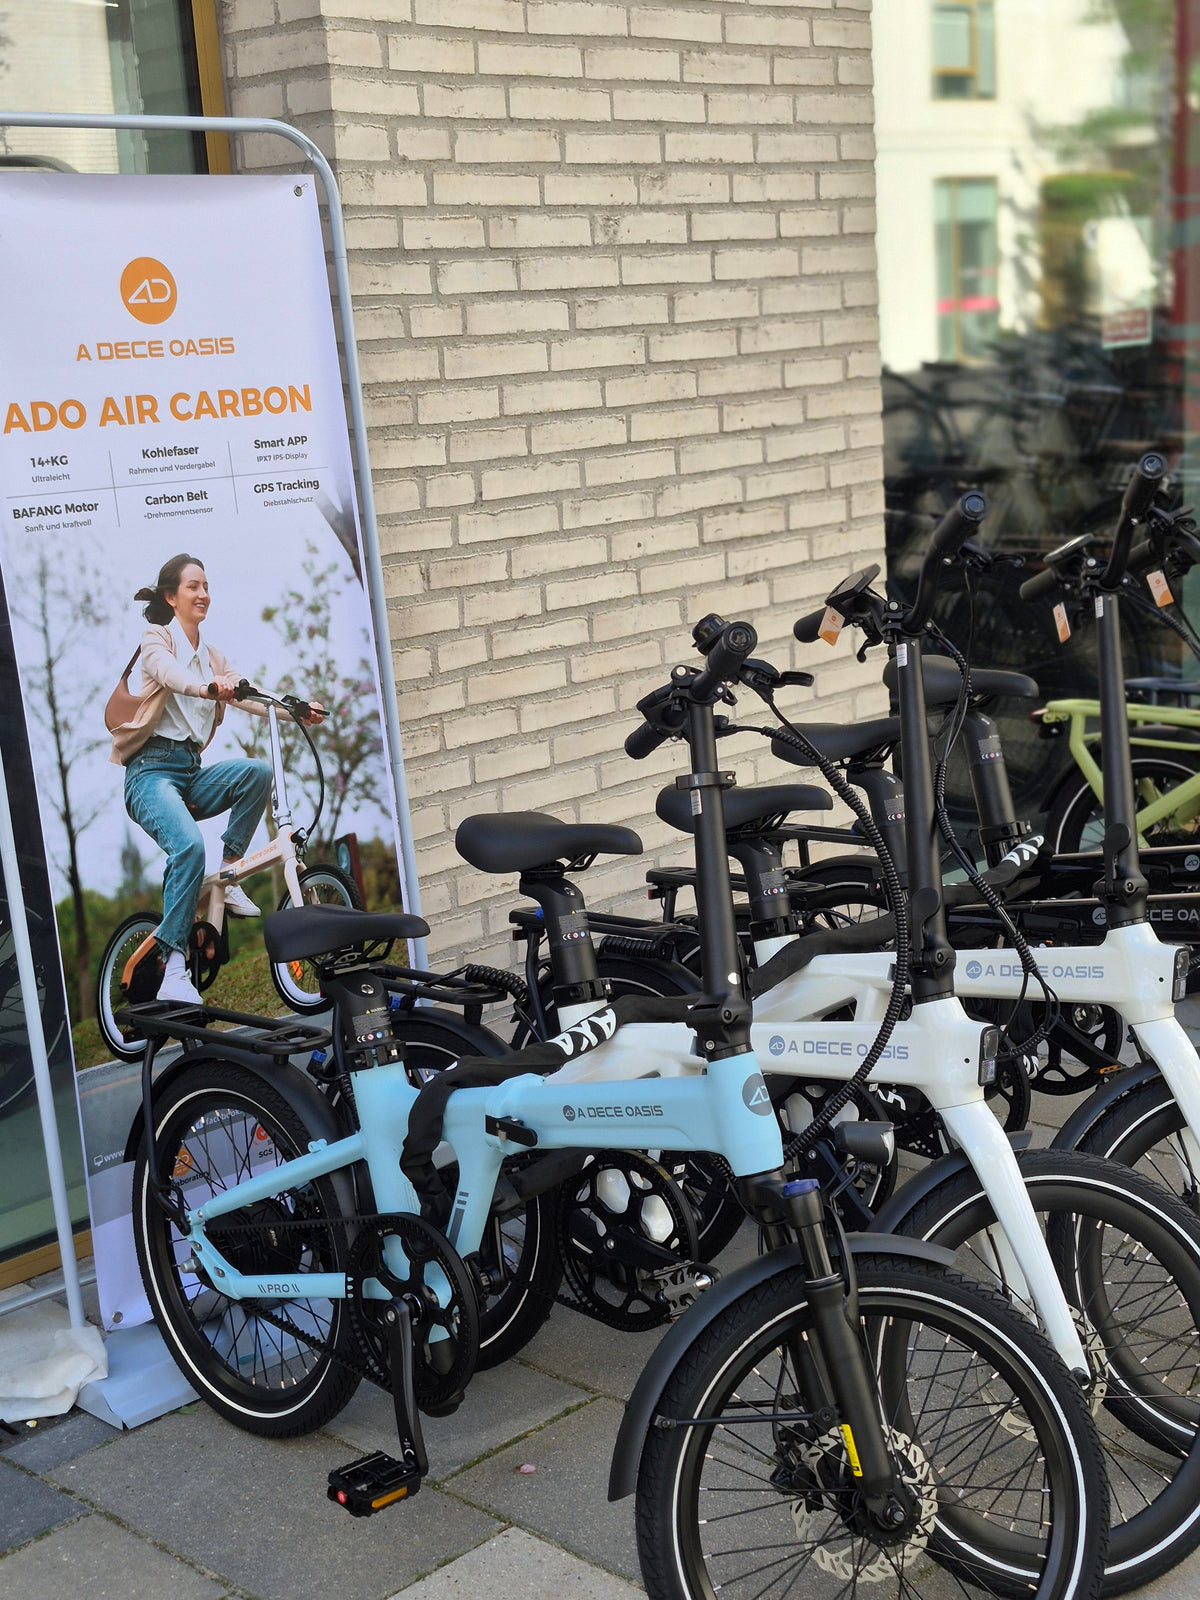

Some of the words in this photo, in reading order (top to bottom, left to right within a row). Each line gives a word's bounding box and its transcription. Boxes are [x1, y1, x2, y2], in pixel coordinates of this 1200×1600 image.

[76, 344, 92, 362] A
[97, 340, 164, 361] DECE
[169, 337, 235, 357] OASIS
[3, 399, 87, 434] ADO
[99, 394, 160, 427] AIR
[170, 384, 312, 421] CARBON
[254, 438, 285, 449] Smart
[287, 435, 308, 446] APP
[142, 445, 199, 459] Kohlefaser
[257, 454, 272, 463] IPX7
[30, 455, 69, 468] 14+KG
[128, 467, 158, 475] Rahmen
[160, 465, 173, 473] und
[174, 461, 216, 471] Vordergabel
[32, 473, 71, 483] Ultraleicht
[254, 483, 275, 494] GPS
[276, 479, 319, 492] Tracking
[145, 493, 184, 506] Carbon
[186, 490, 208, 501] Belt
[263, 496, 314, 507] Diebstahlschutz
[12, 505, 62, 519] BAFANG
[65, 502, 99, 514] Motor
[25, 524, 44, 533] Sanft
[46, 523, 60, 531] und
[62, 519, 92, 529] kraftvoll
[985, 965, 995, 977] A
[1000, 964, 1049, 978] DEE
[1052, 966, 1105, 979] OASIS
[788, 1040, 799, 1053] A
[803, 1040, 852, 1056] DECE
[856, 1043, 909, 1060] OSIS
[578, 1108, 586, 1118] A
[587, 1106, 624, 1118] DECE
[625, 1105, 664, 1117] OASIS
[267, 1284, 290, 1293] PRO
